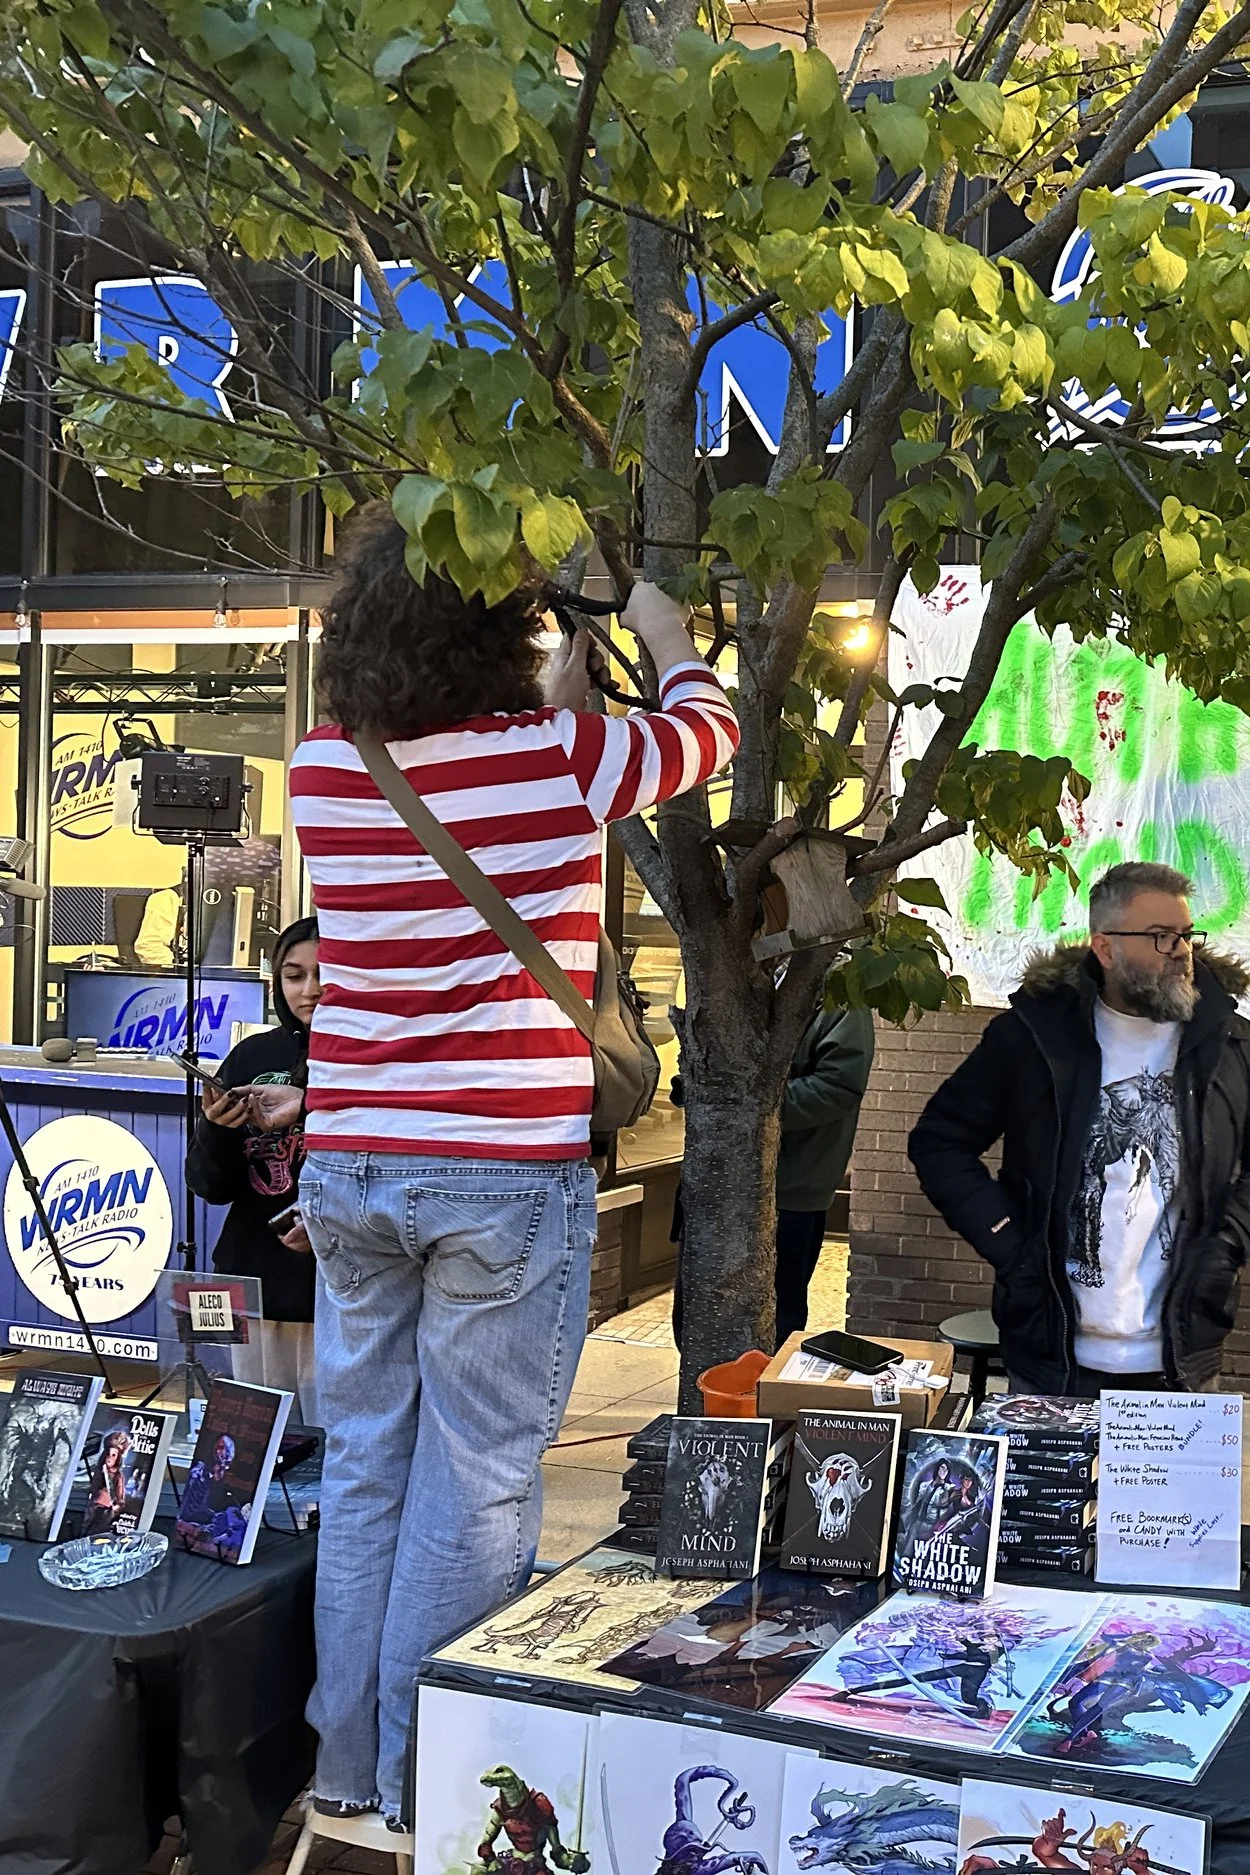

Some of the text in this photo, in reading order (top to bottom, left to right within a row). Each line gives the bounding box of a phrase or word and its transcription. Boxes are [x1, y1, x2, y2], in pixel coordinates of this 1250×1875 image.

[177, 1033, 212, 1050] RDIO
[54, 1165, 100, 1194] AM 1410
[20, 1167, 154, 1252] WRMN
[37, 1207, 138, 1256] NS-TALK RADIO
[72, 1276, 124, 1291] YEARS
[199, 1294, 222, 1310] ALECO
[199, 1312, 225, 1327] JULIUS
[15, 1329, 151, 1358] wrmn140.com
[1106, 1397, 1119, 1408] The
[1222, 1403, 1240, 1416] $20
[130, 1415, 159, 1437] Dolls
[804, 1417, 890, 1432] THE ANIMAL IN MAN
[805, 1429, 887, 1443] VIOLENT MIND
[1178, 1420, 1203, 1451] BUNDLE!
[1221, 1434, 1239, 1446] $50
[129, 1435, 155, 1454] Attic
[677, 1439, 763, 1458] VIOLENT
[1122, 1443, 1140, 1451] FREE
[1105, 1463, 1168, 1473] The White Shadow
[1221, 1466, 1239, 1478] $30
[1142, 1476, 1168, 1486] POSTER
[1004, 1489, 1028, 1497] ADOW
[1110, 1511, 1192, 1525] FREE BOOKMARK(S)
[933, 1530, 953, 1544] THE
[1134, 1525, 1162, 1536] CANDY
[1167, 1528, 1185, 1536] WITH
[681, 1533, 736, 1552] MIND
[998, 1535, 1021, 1543] ADOW
[914, 1539, 970, 1565] WHITE
[899, 1556, 981, 1586] SHADOW
[907, 1578, 929, 1588] OSEPH
